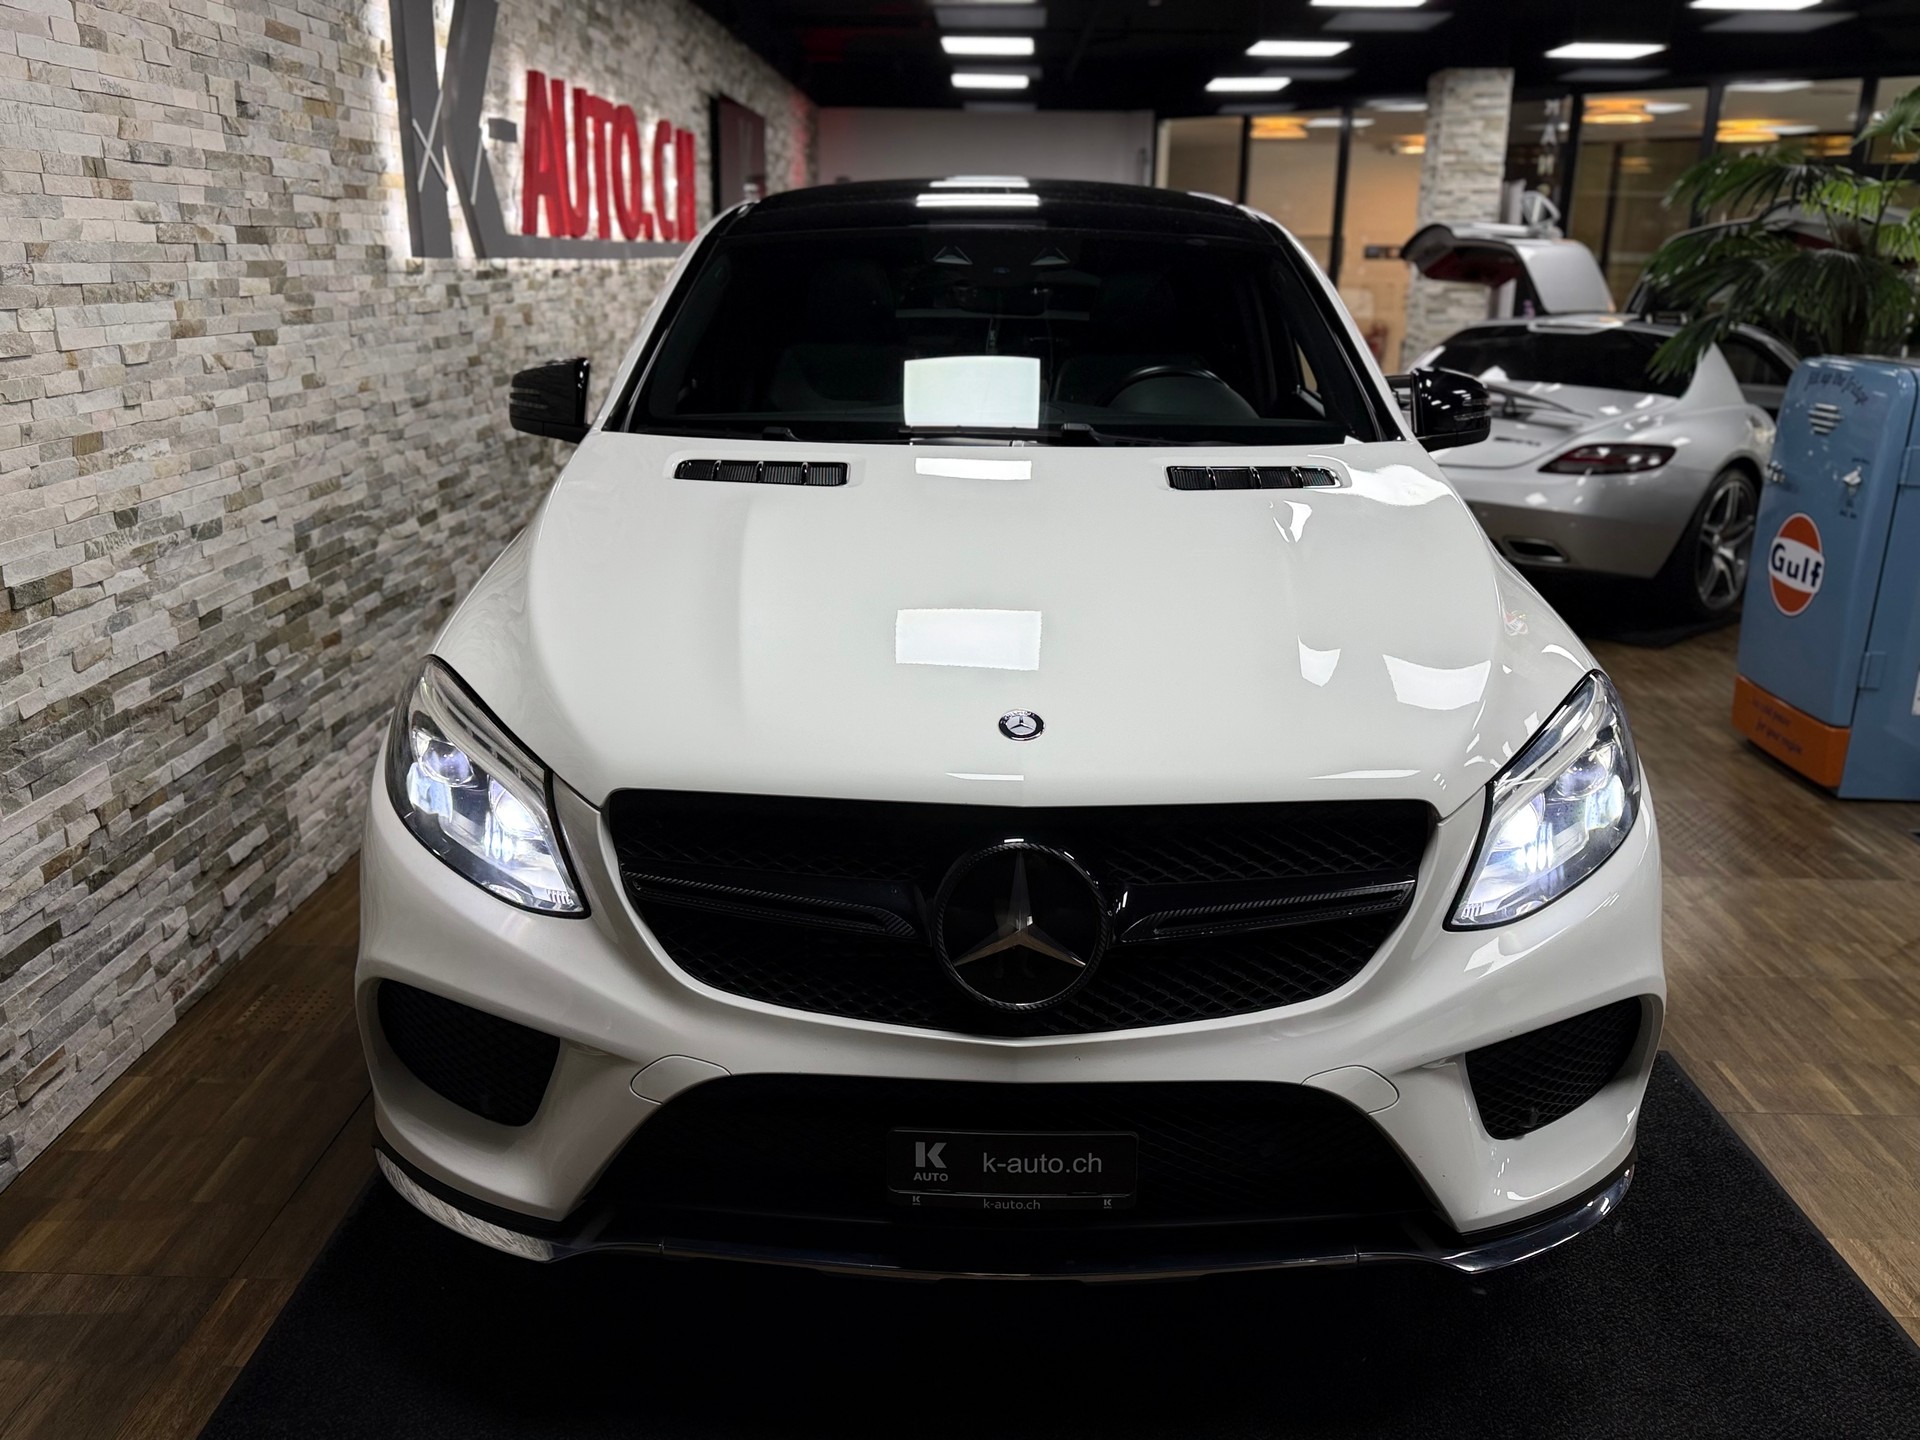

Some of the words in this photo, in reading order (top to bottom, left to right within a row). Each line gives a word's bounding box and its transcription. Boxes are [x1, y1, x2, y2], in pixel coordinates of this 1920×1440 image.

[1771, 542, 1822, 588] Gulf
[915, 1141, 948, 1169] K
[982, 1152, 1103, 1174] k-auto.ch
[913, 1172, 949, 1182] AUTO
[983, 1198, 1041, 1210] k-auto.ch
